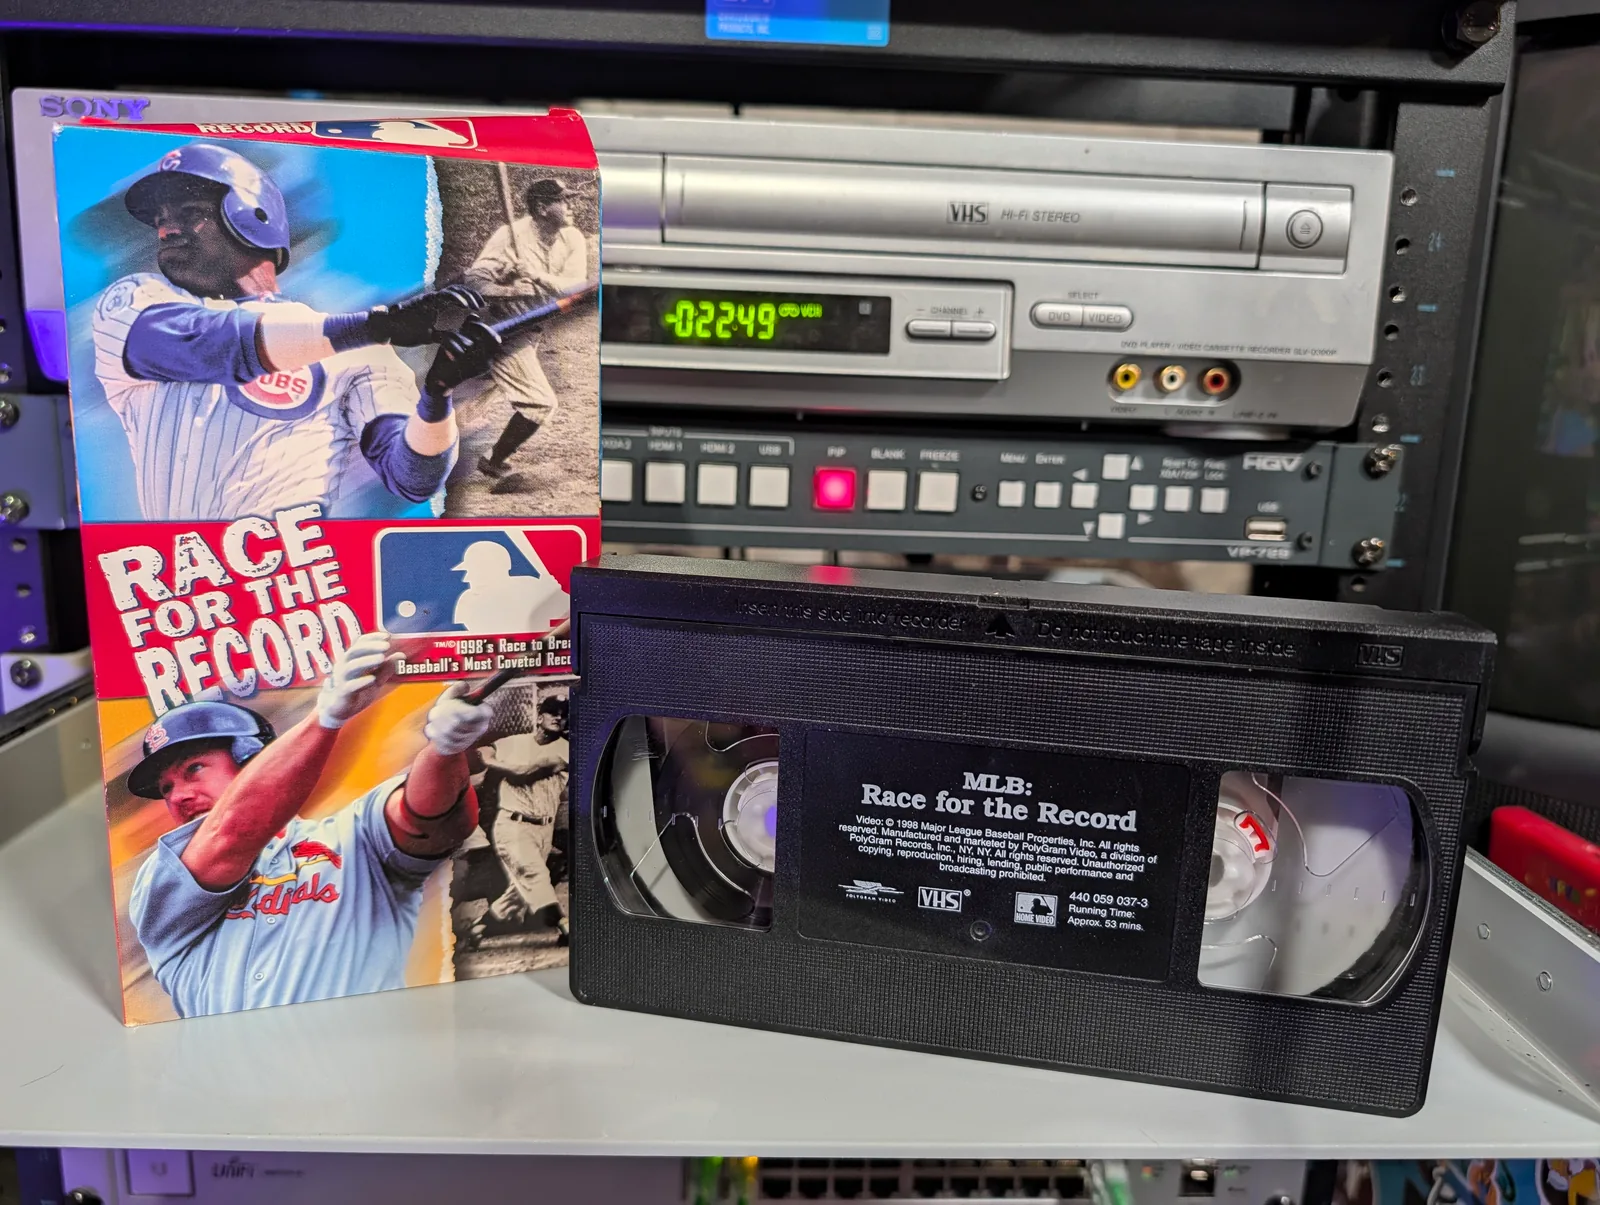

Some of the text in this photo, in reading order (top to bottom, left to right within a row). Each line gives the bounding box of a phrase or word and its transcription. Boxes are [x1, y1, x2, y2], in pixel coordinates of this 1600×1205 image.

[39, 94, 151, 121] SONY
[197, 121, 313, 134] RECORD
[950, 203, 986, 223] VHS
[1032, 209, 1081, 223] STEREO
[1048, 311, 1071, 323] DVD
[1088, 313, 1123, 325] VIDEO
[758, 443, 783, 456] USB
[871, 447, 906, 460] BLANK
[919, 448, 961, 462] FREEZE
[97, 503, 335, 612] RACE
[246, 561, 348, 615] THE
[120, 590, 237, 649] FOR
[735, 598, 966, 631] Insert this side into recorder
[499, 638, 526, 653] Race
[531, 639, 543, 651] to
[548, 637, 571, 650] Bre
[1036, 621, 1297, 659] Do not touch the tape inside
[133, 601, 363, 719] RECORD
[397, 658, 459, 675] Baseball's
[464, 656, 493, 671] Most
[497, 654, 542, 670] Coveted
[1360, 645, 1402, 666] VHS
[962, 771, 1033, 797] MLB:
[861, 783, 1137, 833] Race for the Record
[856, 814, 884, 826] Video:
[896, 819, 919, 830] 1998
[920, 821, 947, 834] Major
[948, 824, 983, 837] League
[984, 828, 1025, 841] Baseball
[1027, 832, 1076, 849] Properties,
[1079, 838, 1096, 849] Inc.
[1098, 840, 1111, 850] All
[1113, 841, 1140, 853] rights
[838, 824, 879, 835] reserved.
[881, 827, 942, 842] Manufactured
[944, 835, 961, 844] and
[963, 836, 1006, 850] marketed
[1008, 840, 1019, 851] by
[1022, 841, 1067, 855] PolyGram
[1069, 847, 1098, 860] Video,
[1109, 852, 1145, 864] division
[1147, 854, 1158, 864] of
[849, 833, 1145, 873] PolyGram Records, Inc., NY, NY. All rights reserved. Unauthorized
[858, 844, 1134, 882] copying, reproduction, hiring, lending, public performance and
[939, 862, 1047, 882] broadcasting prohibited.
[845, 893, 876, 901] POLYGRAM
[1069, 891, 1149, 908] 440 059 037-3
[1016, 912, 1054, 925] HOME VIDEO
[1068, 904, 1136, 919] Running Time:
[1067, 915, 1145, 931] Approx. 53 mins.
